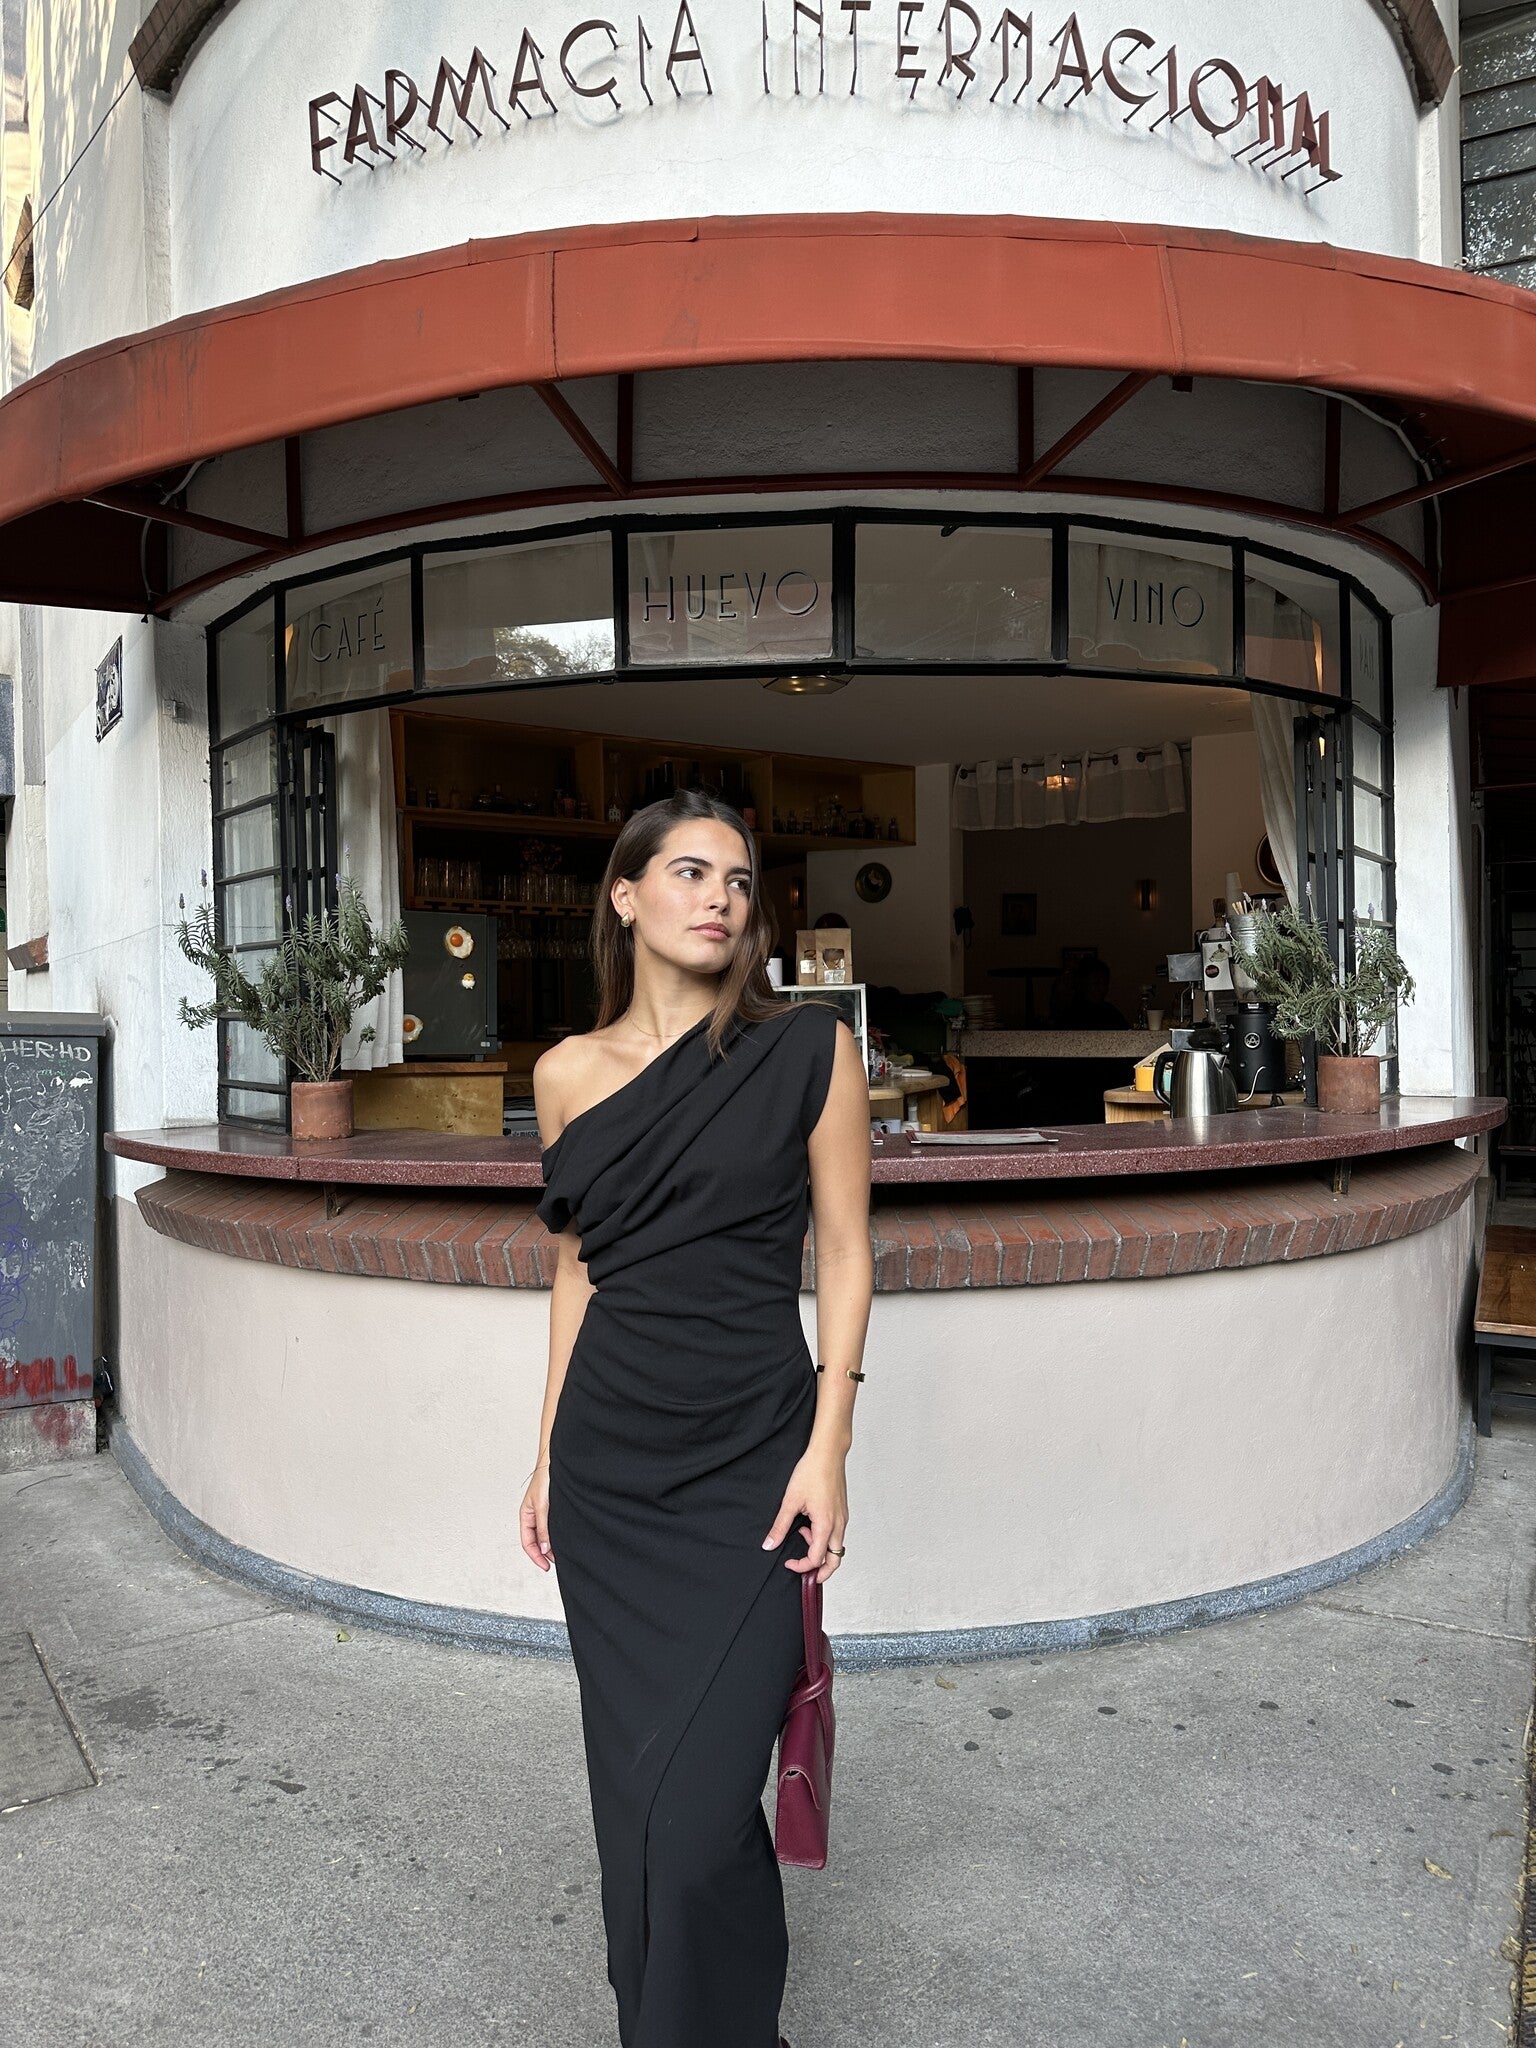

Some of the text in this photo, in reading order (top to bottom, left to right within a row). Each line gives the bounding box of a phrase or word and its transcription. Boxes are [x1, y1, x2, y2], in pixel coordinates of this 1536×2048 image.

[308, 0, 1343, 182] FARMACIA INTERNACIONAL
[643, 570, 819, 624] HUEVO
[1106, 575, 1205, 628] VINO
[310, 598, 386, 663] CAFÉ
